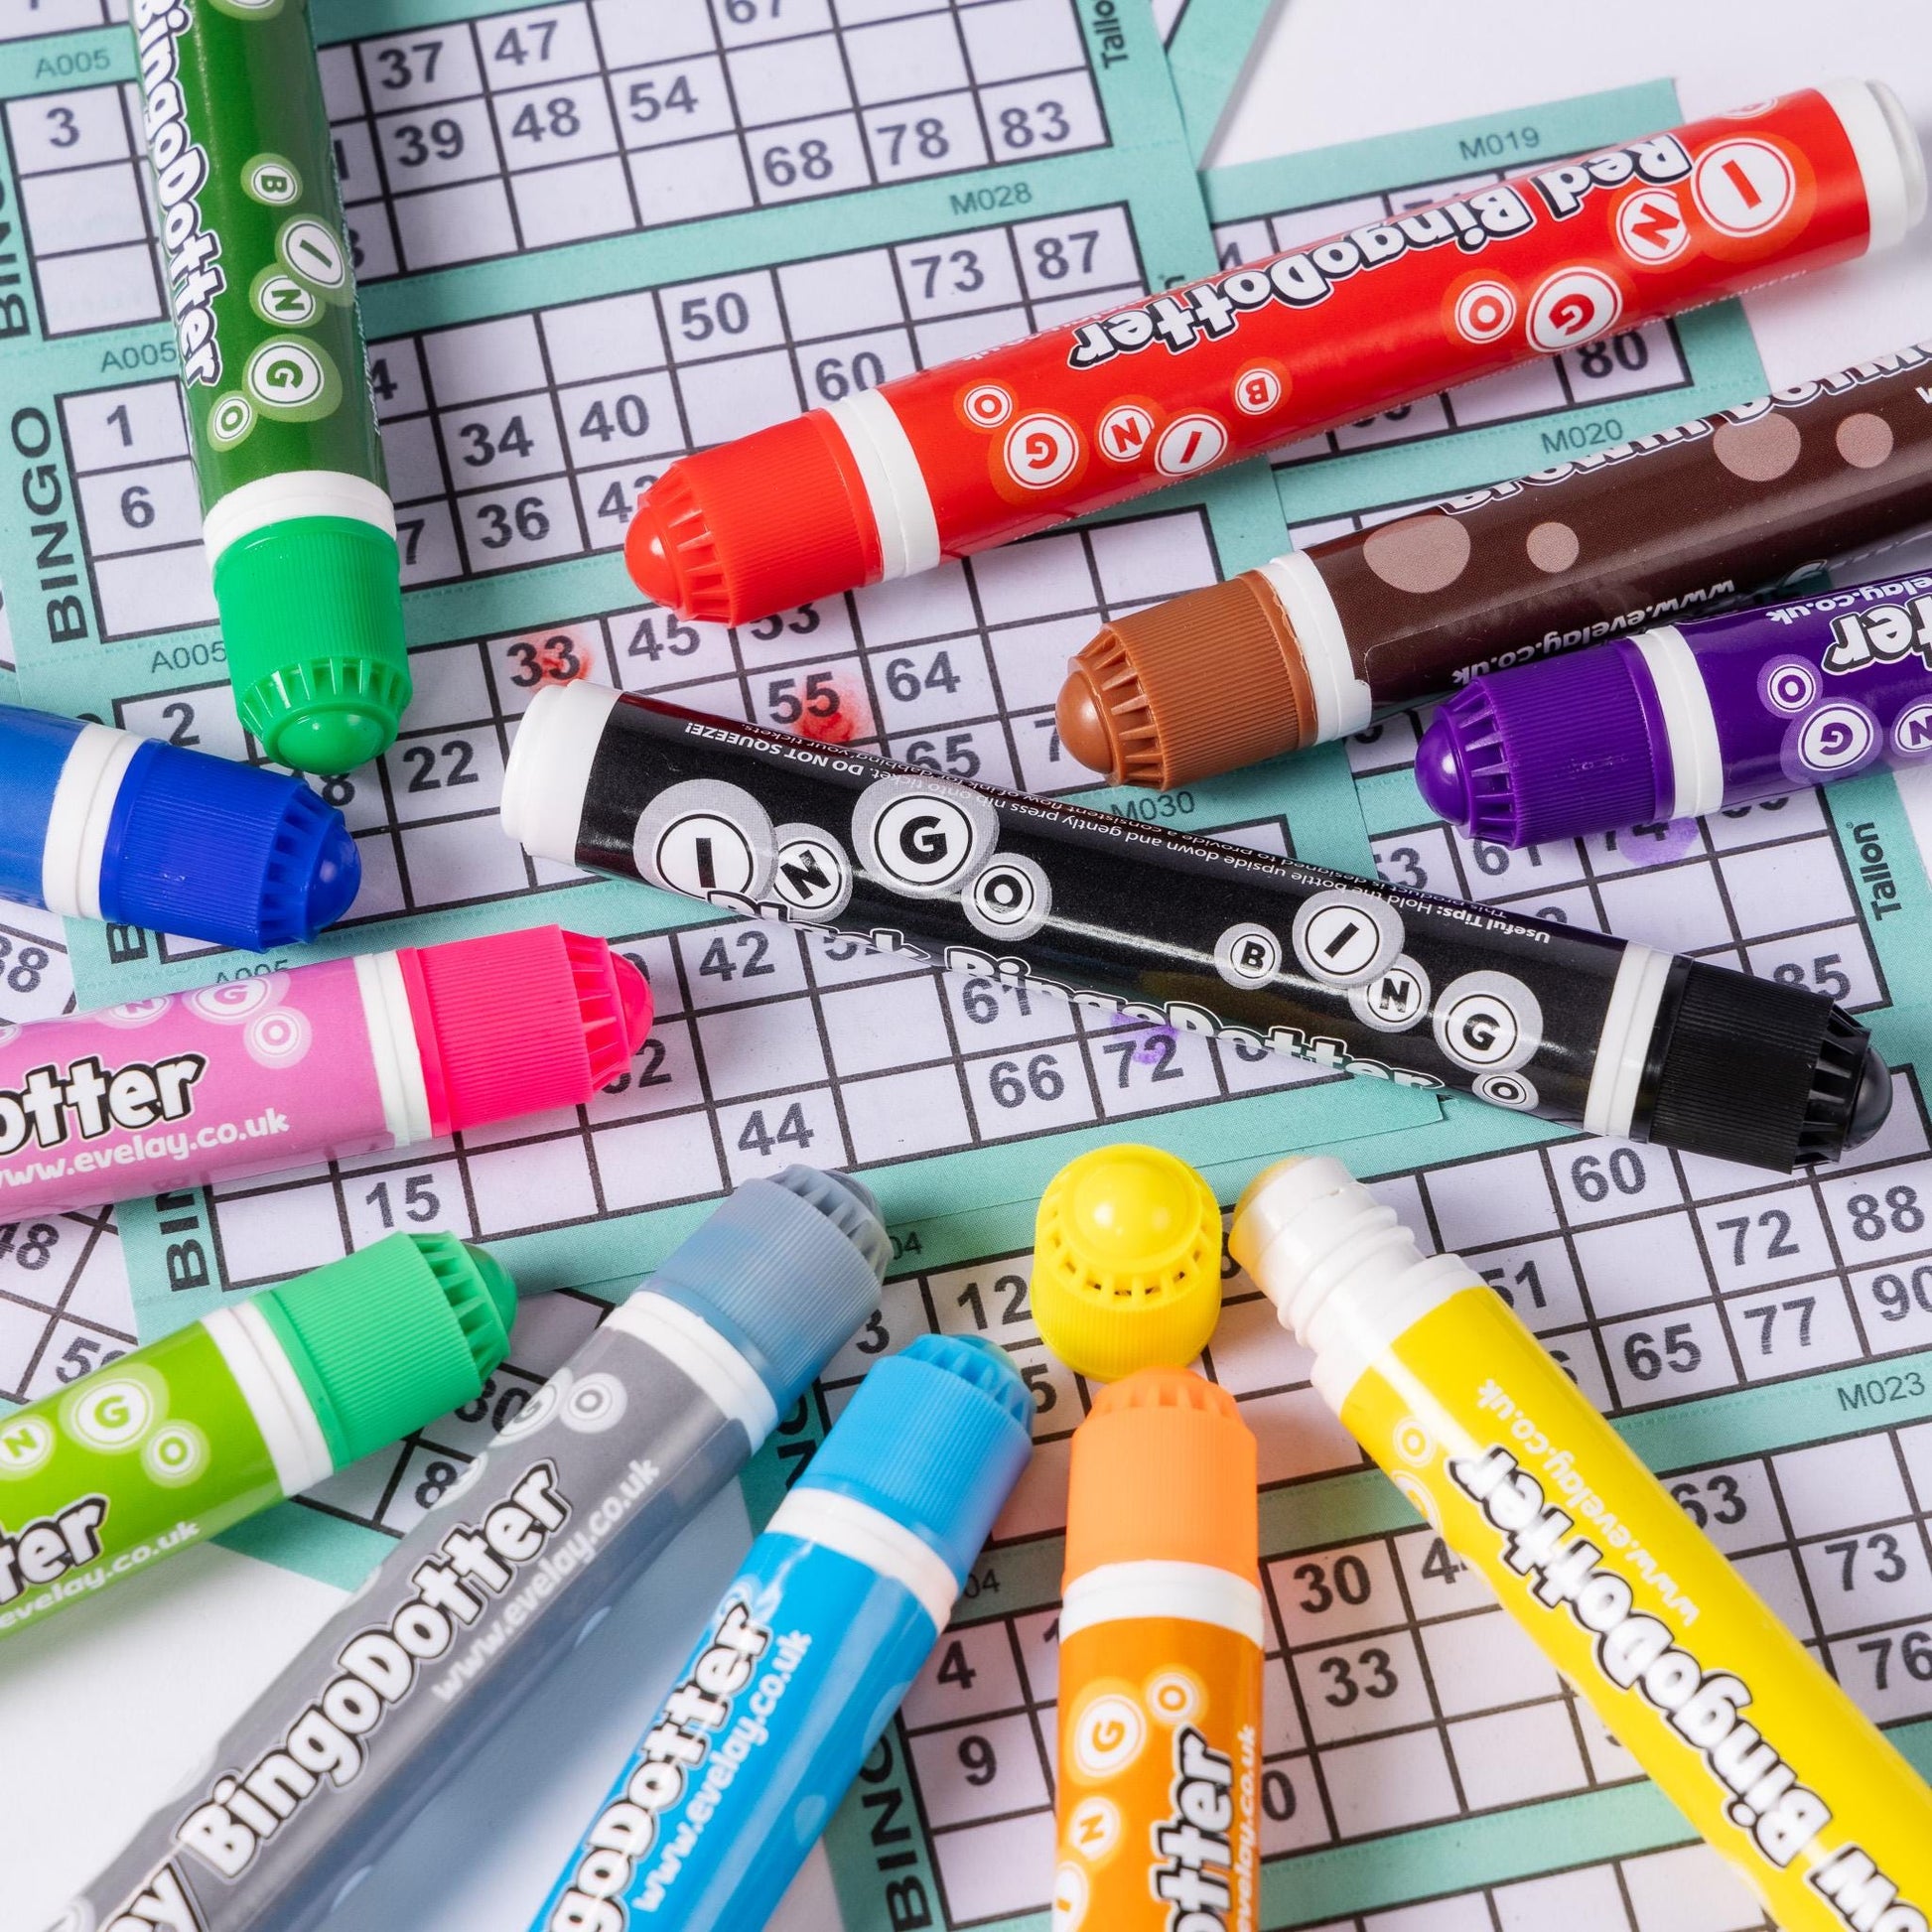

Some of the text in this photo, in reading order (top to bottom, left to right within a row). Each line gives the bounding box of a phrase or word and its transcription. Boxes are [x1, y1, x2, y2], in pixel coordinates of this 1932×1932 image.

[494, 20, 558, 68] 47
[1093, 0, 1129, 69] Tallo
[36, 50, 111, 79] A005
[377, 41, 444, 91] 37
[511, 96, 582, 144] 48
[627, 74, 698, 123] 54
[46, 107, 80, 148] 3
[393, 117, 465, 168] 39
[877, 118, 950, 167] 78
[999, 99, 1070, 150] 83
[1459, 127, 1540, 161] M019
[762, 138, 834, 188] 68
[1530, 133, 1693, 219] Red
[949, 182, 1033, 216] M028
[910, 248, 985, 300] 73
[1034, 230, 1100, 280] 87
[1066, 183, 1538, 371] BingoDotter
[680, 291, 750, 342] 50
[101, 341, 178, 373] A005
[815, 351, 886, 402] 60
[1579, 331, 1649, 379] 80
[106, 405, 134, 447] 1
[460, 415, 534, 468] 34
[580, 393, 649, 442] 40
[1540, 418, 1623, 455] M020
[11, 407, 88, 643] BINGO
[121, 485, 155, 528] 6
[477, 496, 550, 548] 36
[151, 640, 227, 673] A005
[627, 616, 700, 661] 45
[1452, 579, 1735, 685] www.evelay.co.uk
[507, 634, 580, 687] 33
[886, 650, 960, 702] 64
[767, 670, 840, 725] 55
[162, 702, 200, 745] 2
[684, 721, 782, 756] SQUEEZE!
[402, 739, 479, 793] 22
[784, 746, 828, 766] NOT
[830, 758, 864, 775] DO
[1010, 800, 1058, 822] press
[1060, 812, 1122, 840] gently
[1124, 830, 1162, 850] and
[1165, 840, 1220, 864] down
[1222, 852, 1287, 880] upside
[1290, 870, 1346, 894] bottle
[1386, 893, 1433, 915] Hold
[1435, 903, 1484, 927] Tips:
[699, 930, 774, 982] 42
[1485, 917, 1551, 944] Useful
[1773, 953, 1852, 1002] 85
[989, 1053, 1065, 1109] 66
[1102, 1034, 1183, 1089] 72
[0, 1107, 290, 1187] ww.evelay.co.uk
[738, 1103, 814, 1157] 44
[364, 1173, 441, 1228] 15
[1571, 1148, 1646, 1202] 60
[1716, 1209, 1800, 1267] 72
[1847, 1185, 1924, 1241] 88
[957, 1275, 1033, 1330] 12
[1871, 1265, 1932, 1321] 90
[1623, 1323, 1702, 1381] 65
[1743, 1298, 1816, 1355] 77
[1837, 1373, 1925, 1411] M023
[1476, 1378, 1700, 1627] www.evelay.co.uk
[0, 1521, 200, 1629] evelay.co.uk
[432, 1456, 659, 1702] www.evelay.co.uk
[1294, 1555, 1371, 1613] 30
[1825, 1533, 1906, 1590] 73
[175, 1458, 572, 1878] BingoDotter
[936, 1640, 977, 1688] 4
[1318, 1648, 1398, 1708] 33
[1449, 1446, 1834, 1868] BingoDotter
[1858, 1631, 1932, 1691] 76
[632, 1630, 812, 1912] www.evelay.co.uk
[958, 1736, 997, 1786] 9
